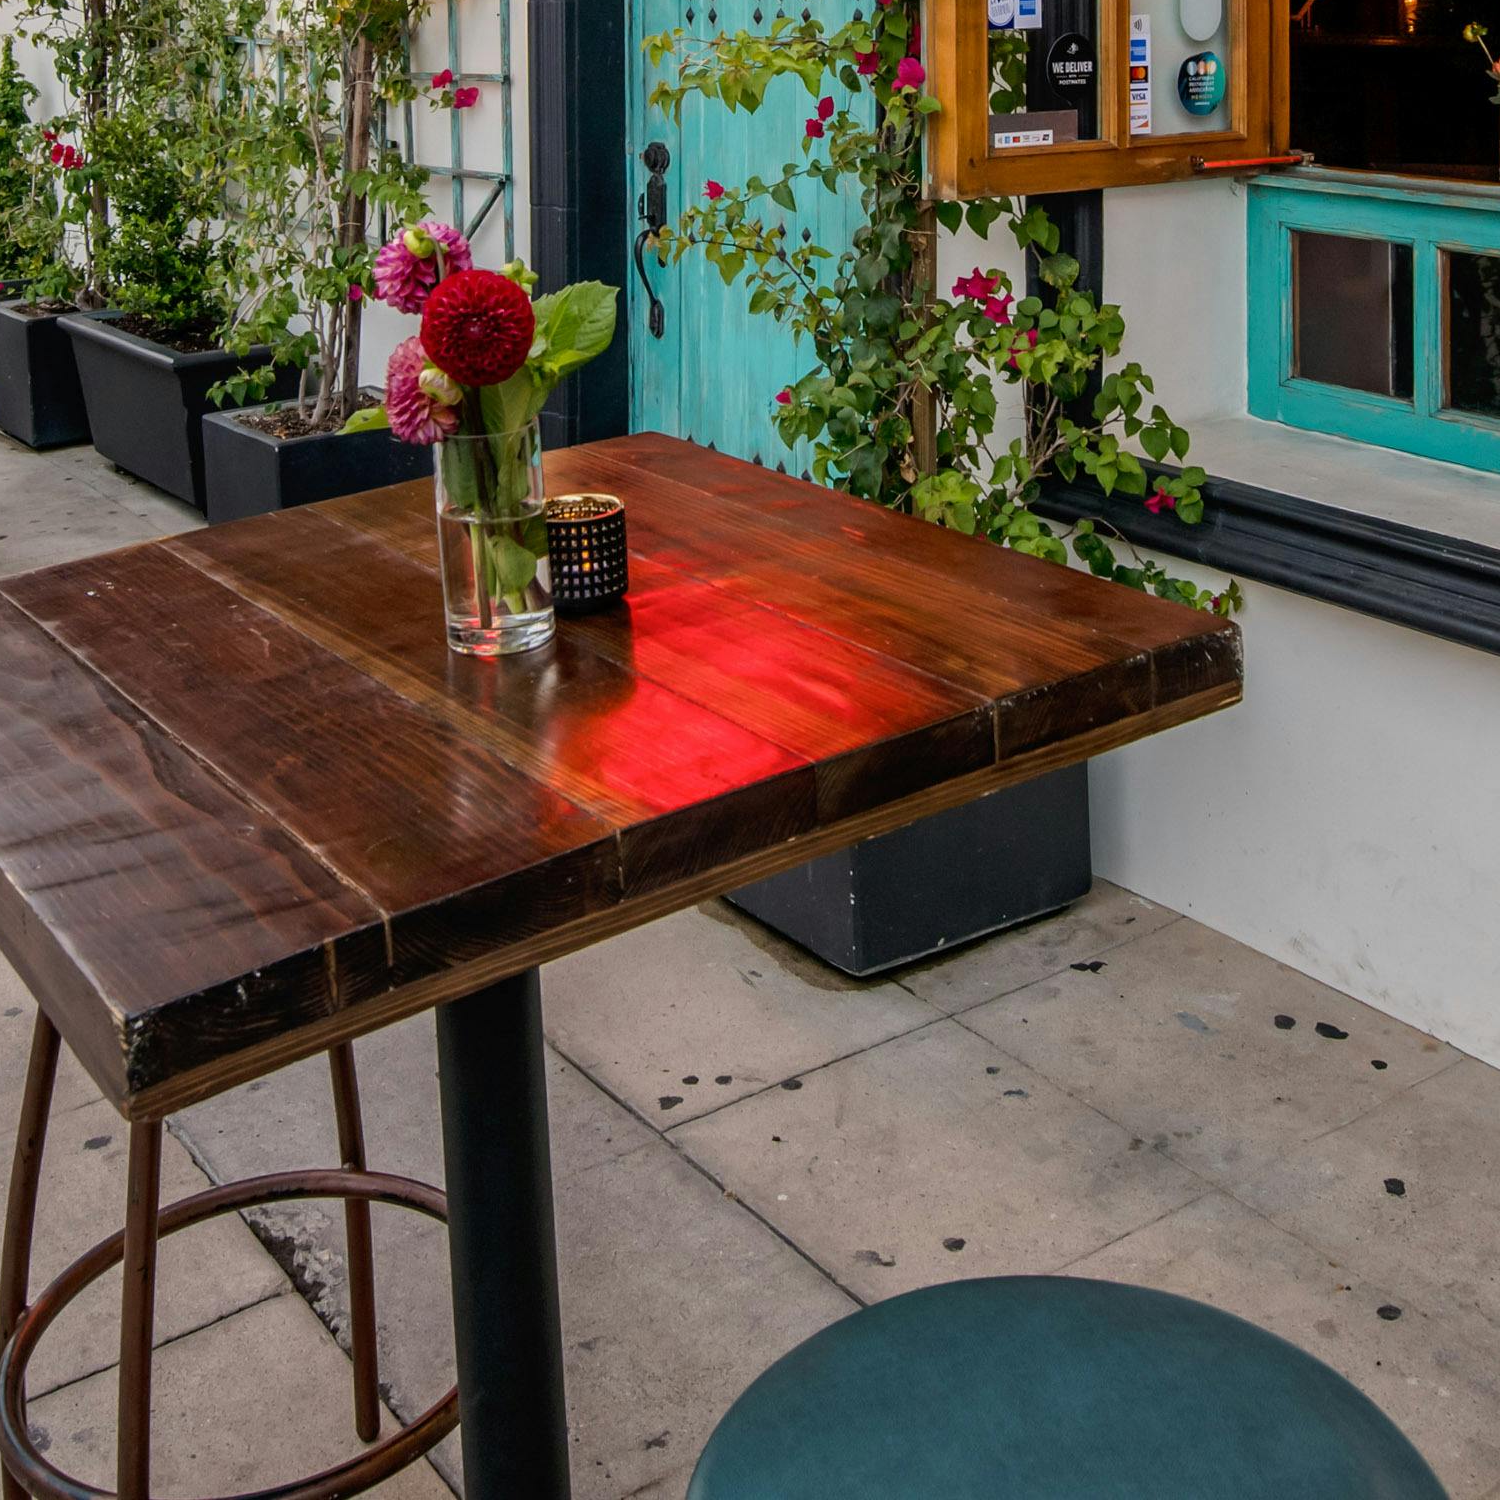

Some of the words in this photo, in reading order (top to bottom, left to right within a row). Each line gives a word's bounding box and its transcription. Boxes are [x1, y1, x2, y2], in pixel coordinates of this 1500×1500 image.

[1052, 61, 1064, 73] WE
[1065, 60, 1093, 73] DELIVER
[1132, 92, 1146, 100] VISA
